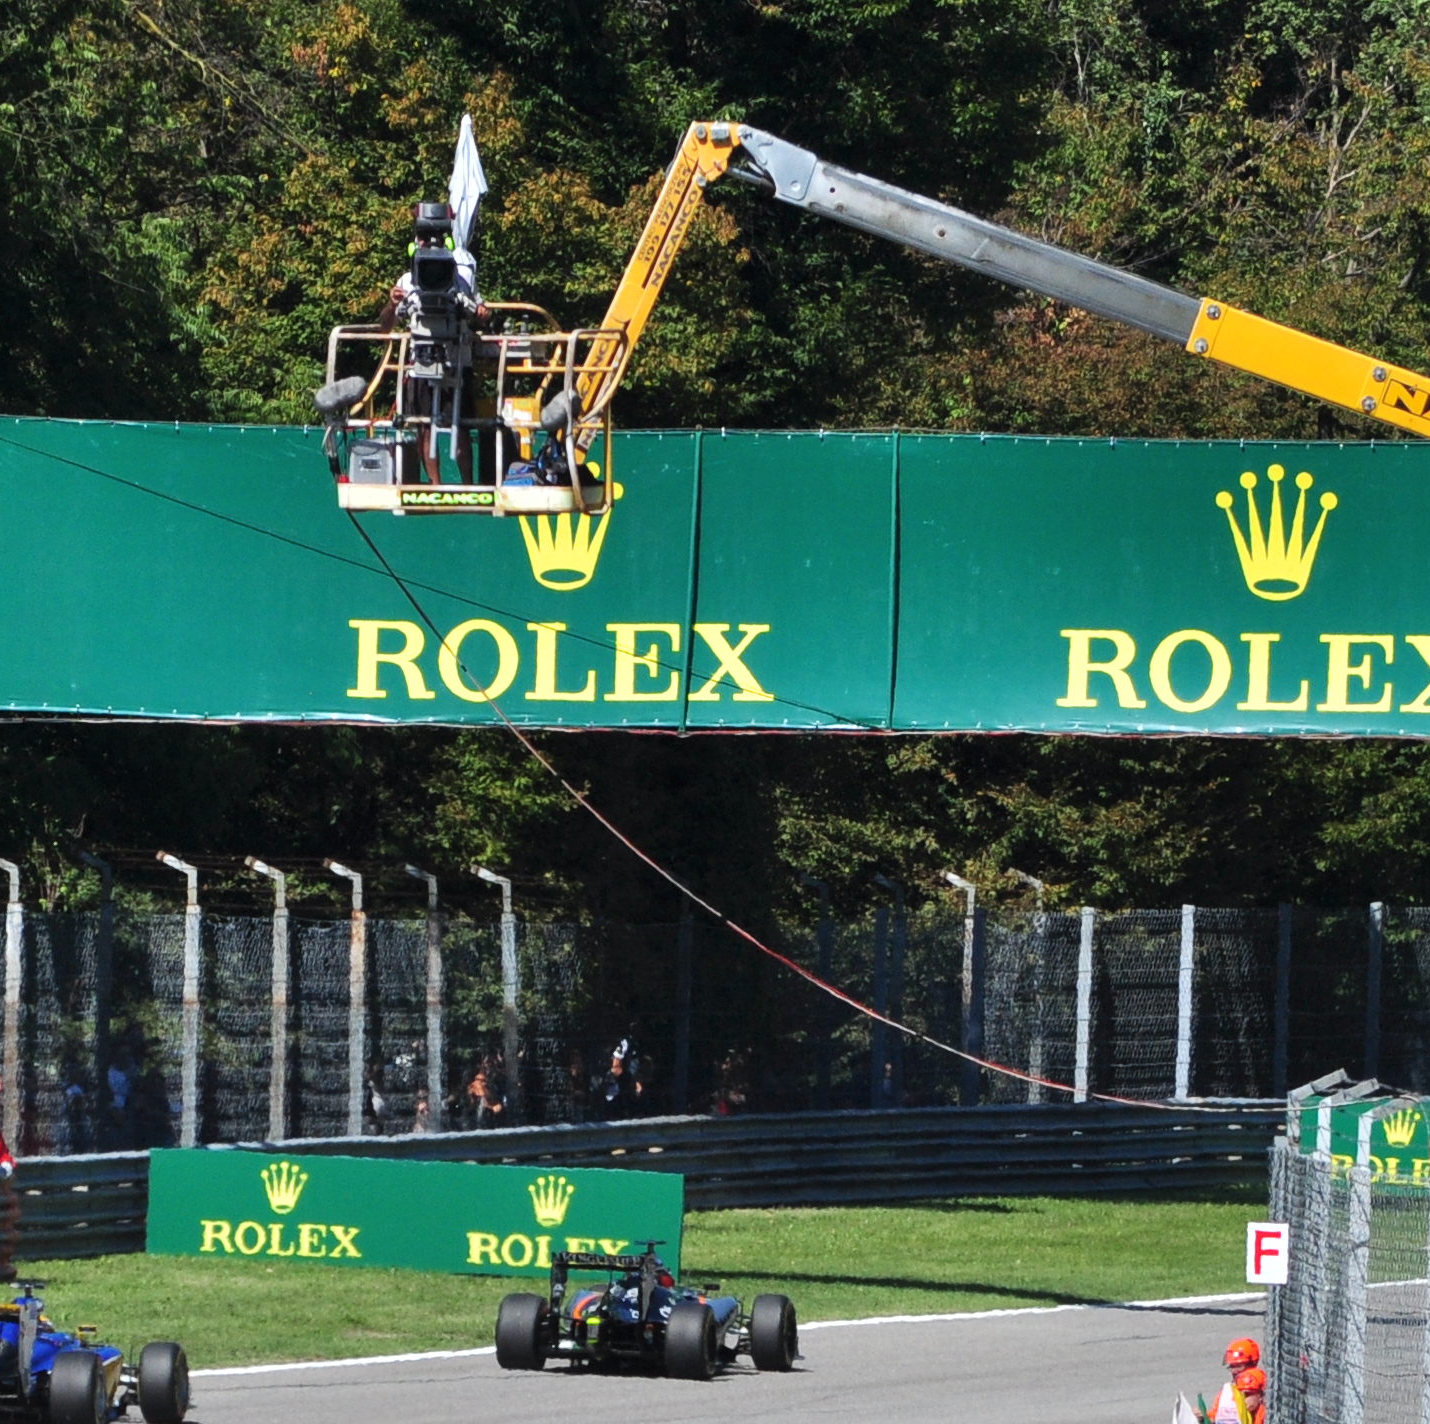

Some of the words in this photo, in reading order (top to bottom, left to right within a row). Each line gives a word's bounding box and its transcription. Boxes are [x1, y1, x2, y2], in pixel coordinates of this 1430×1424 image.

[644, 235, 660, 261] 199
[660, 202, 674, 226] 177
[651, 190, 698, 287] NACANCO
[402, 492, 493, 505] NACANCO
[346, 618, 775, 702] ROLEX
[201, 1220, 360, 1259] ROLEX
[1254, 1230, 1282, 1275] F
